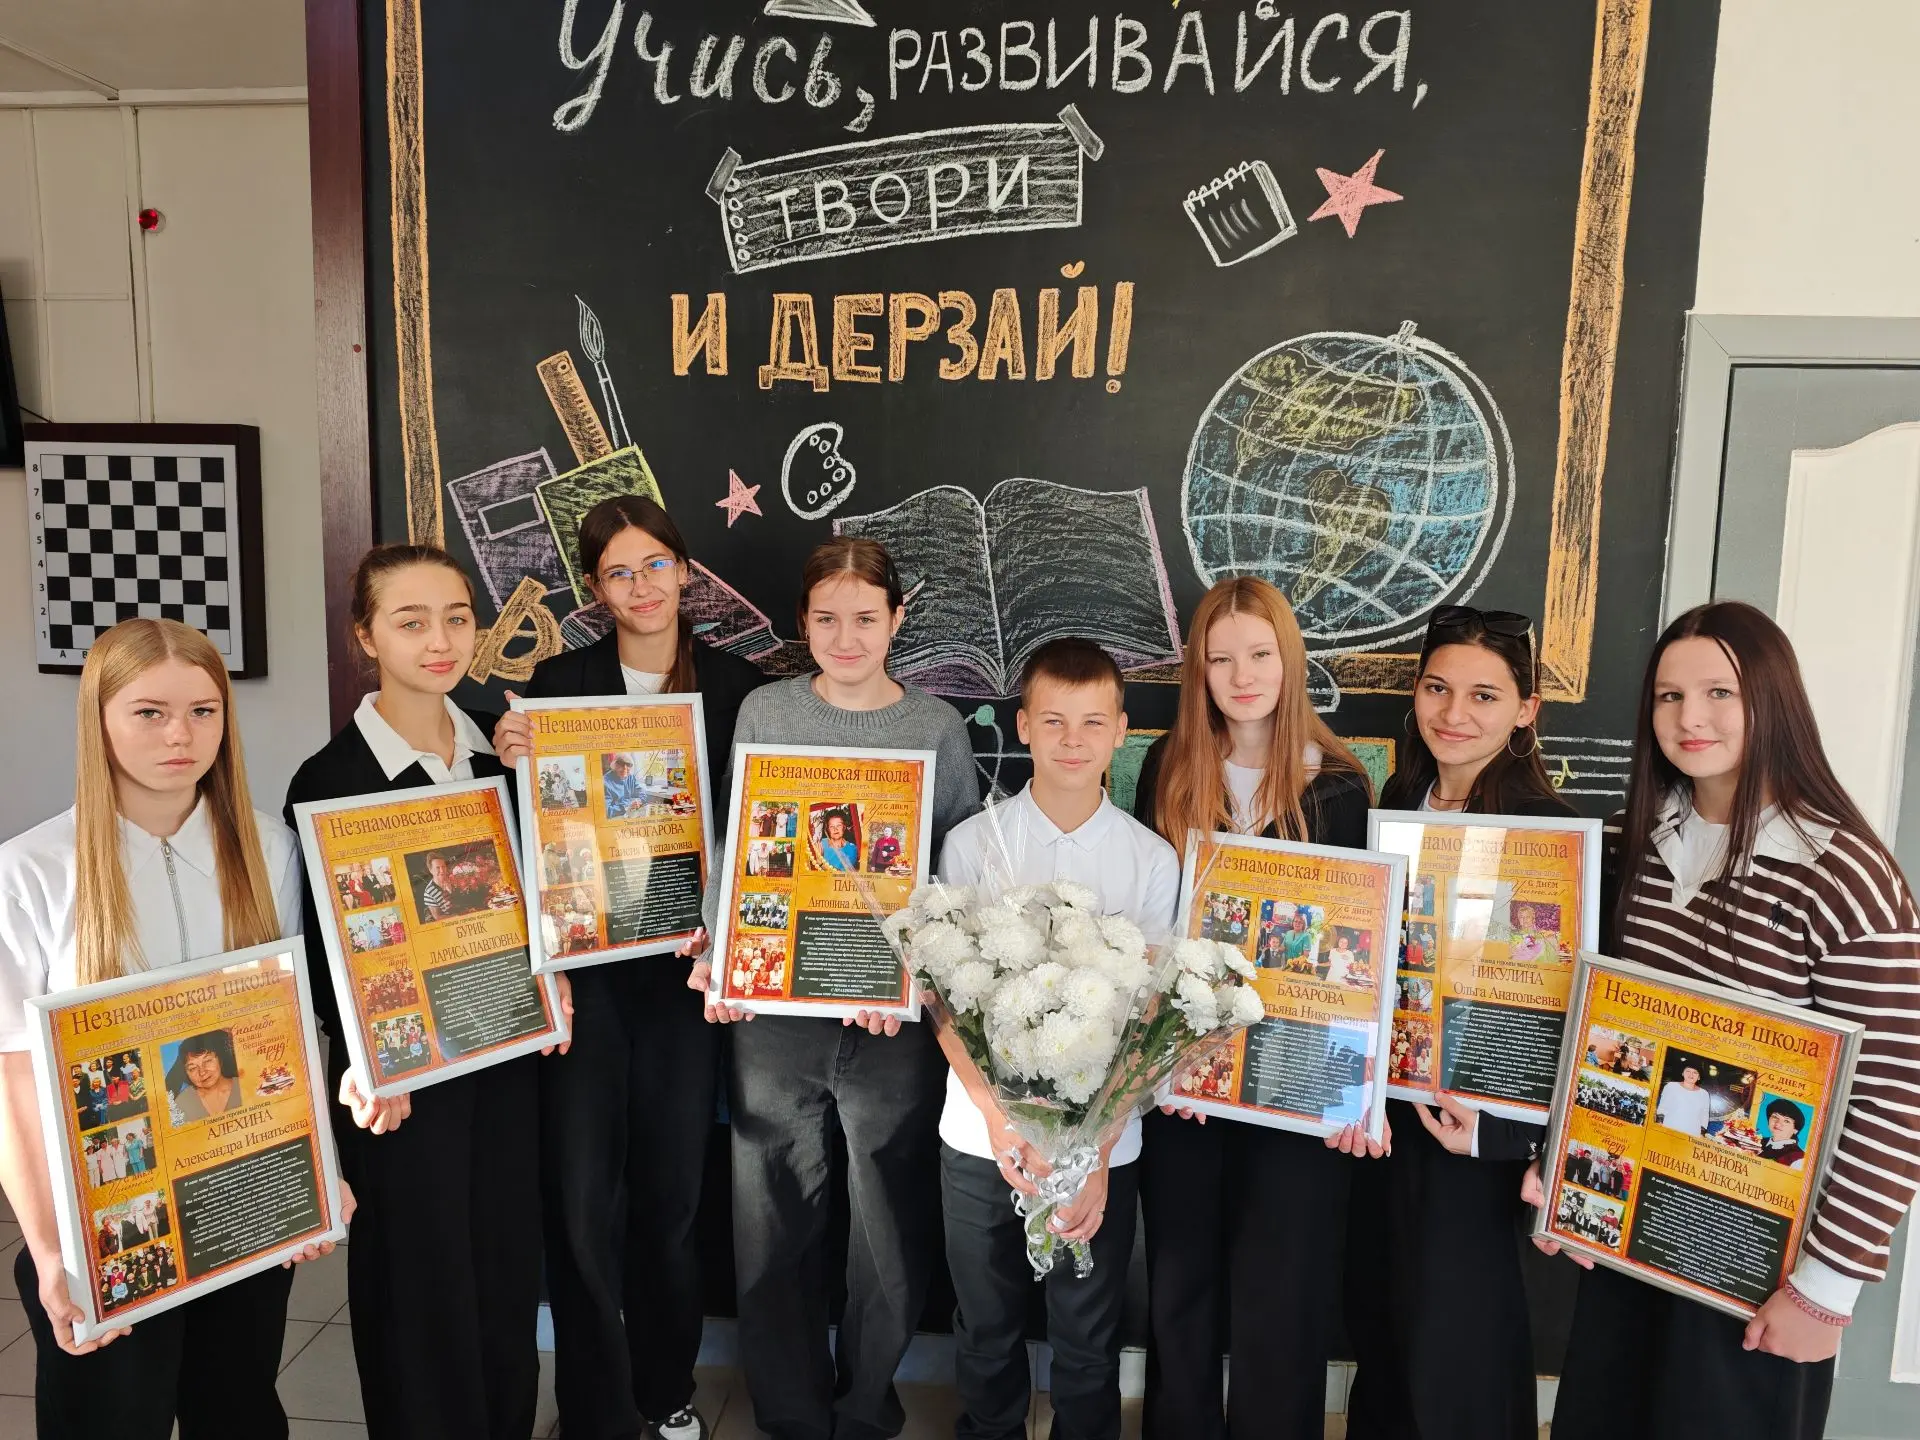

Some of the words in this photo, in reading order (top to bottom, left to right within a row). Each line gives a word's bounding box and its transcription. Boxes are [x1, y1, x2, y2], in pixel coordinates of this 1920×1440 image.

[552, 0, 876, 133] Учись,
[888, 0, 1428, 110] РАЗВИВАЙСЯ,
[765, 155, 1030, 241] ТВОРИ
[670, 292, 729, 377] И
[758, 260, 1136, 394] ДЕРЗАЙ!
[537, 711, 637, 734] Незнамовская
[641, 713, 682, 728] школа
[758, 760, 860, 782] Незнамовская
[864, 768, 910, 782] школа
[331, 810, 440, 838] Незнамовская
[445, 800, 490, 820] школа
[1512, 840, 1569, 858] школа
[1325, 868, 1376, 888] школа
[808, 896, 849, 910] Антонина
[455, 920, 487, 938] БУРИК
[427, 943, 468, 965] ЛАРИСА
[467, 930, 521, 954] ПАВЛОВНА
[1471, 963, 1545, 986] НИКУЛИНА
[72, 985, 217, 1035] Незнамовская
[224, 970, 280, 997] школа
[1276, 982, 1345, 1006] БАЗАРОВА
[1453, 981, 1486, 998] Ольга
[1488, 985, 1561, 1008] Анатольевна
[1299, 1004, 1369, 1029] Николаевна
[1604, 979, 1746, 1036] Незнамовская
[1752, 1024, 1819, 1058] школа
[207, 1109, 273, 1140] АЛЕХИНА
[174, 1140, 242, 1171] Александра
[245, 1118, 309, 1147] Игнатьевна
[1692, 1147, 1749, 1177] БАРАНОВА
[1644, 1149, 1698, 1180] ЛИЛИАНА
[1698, 1169, 1796, 1212] АЛЕКСАНДРОВНА
